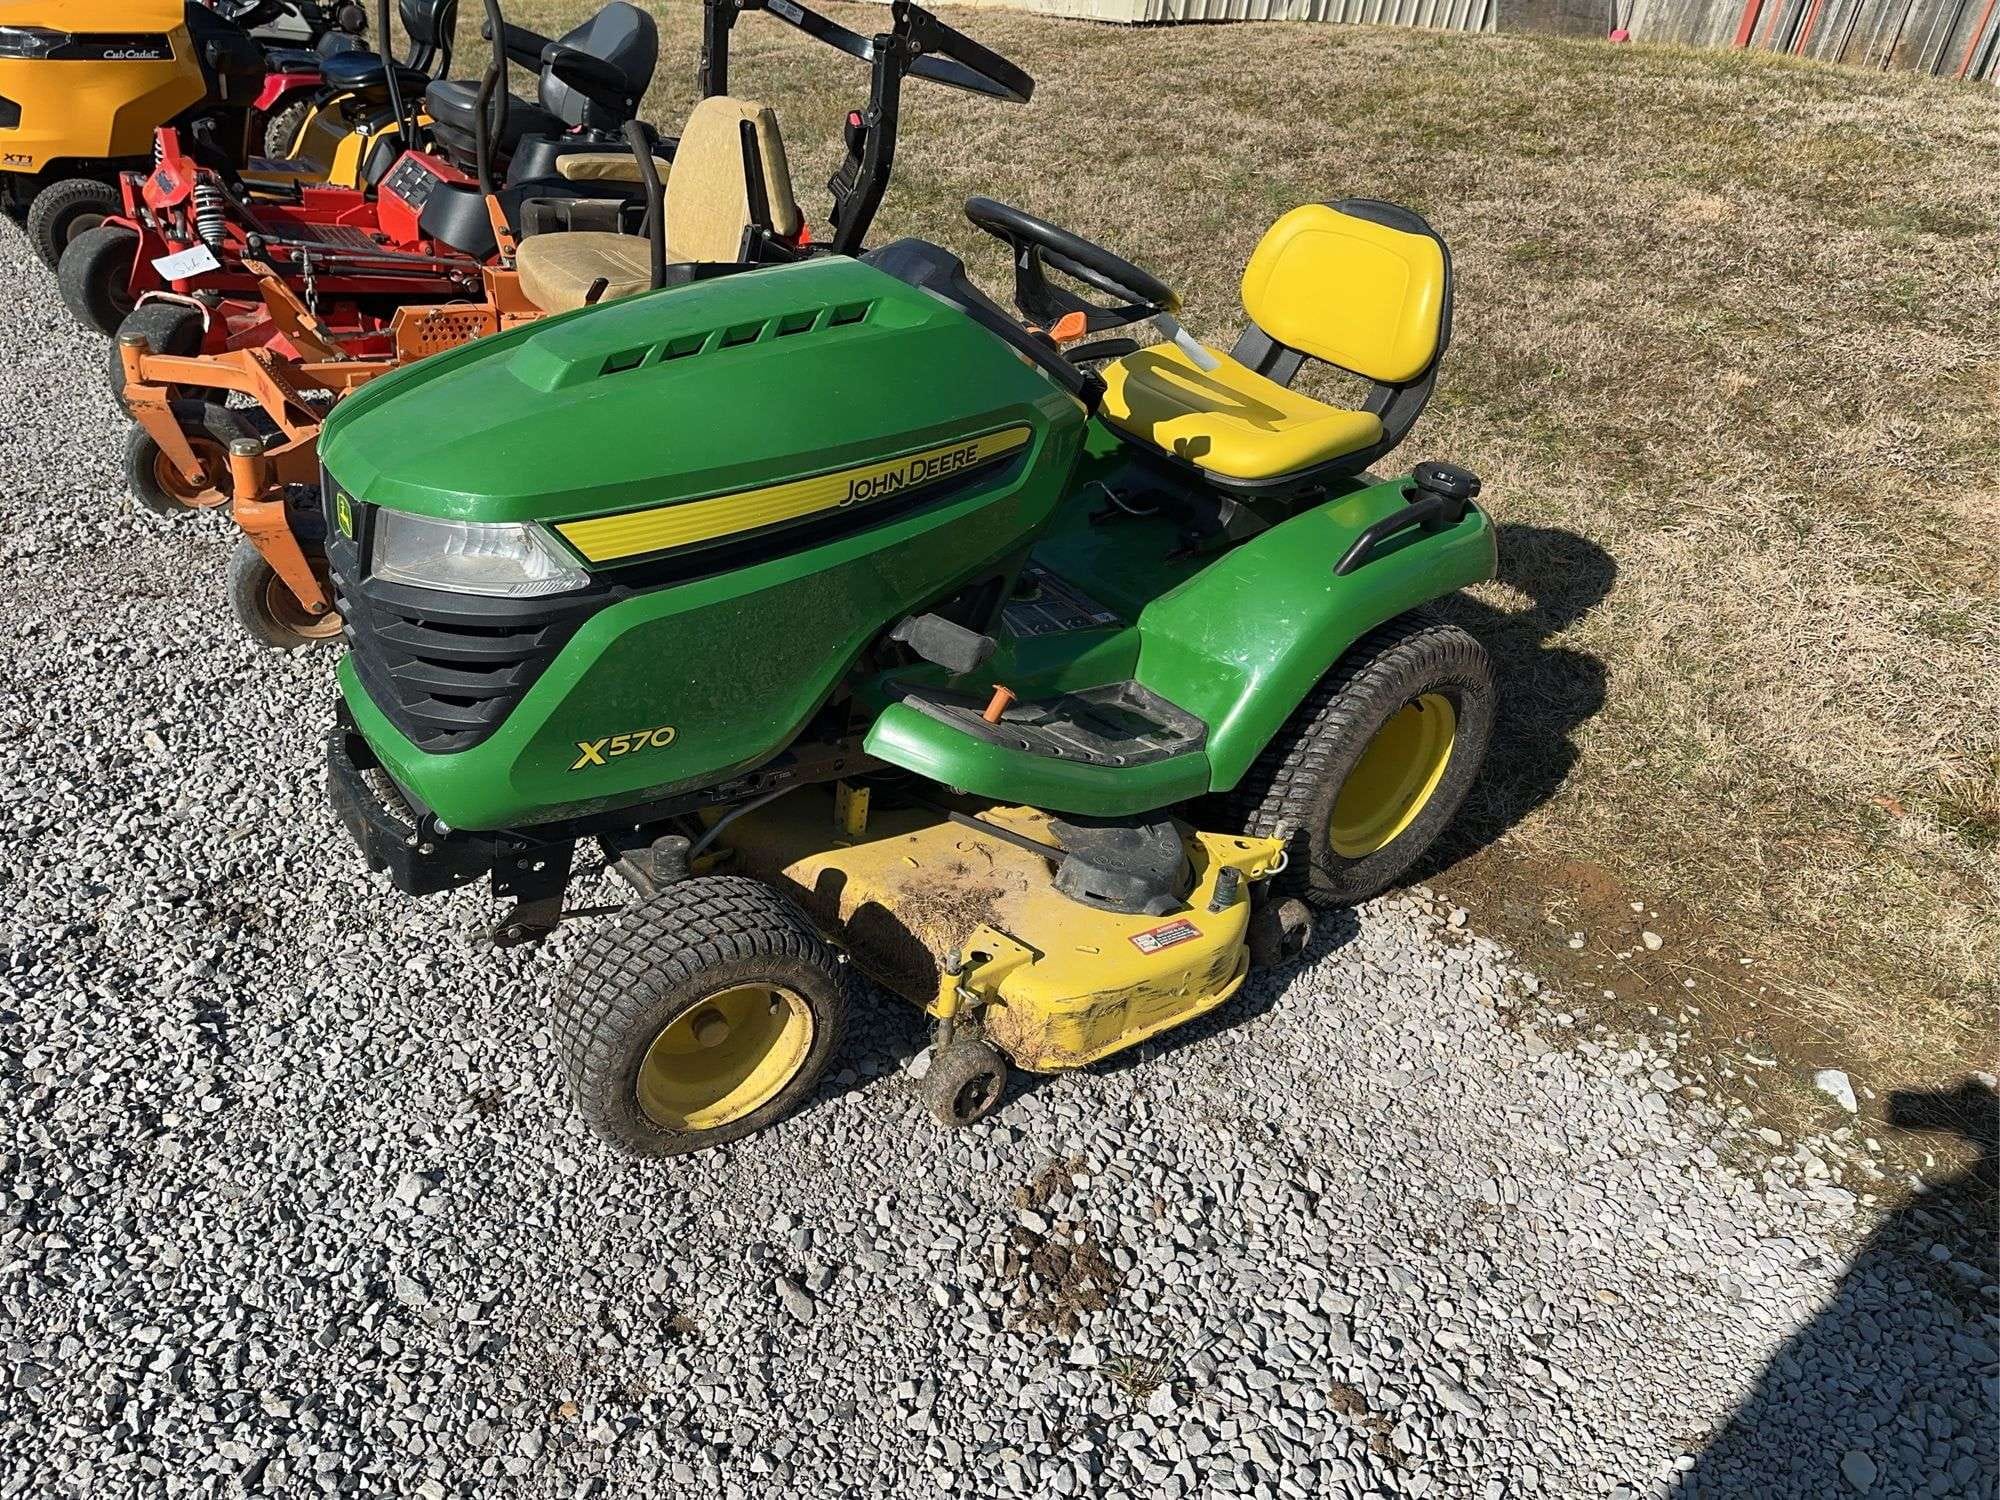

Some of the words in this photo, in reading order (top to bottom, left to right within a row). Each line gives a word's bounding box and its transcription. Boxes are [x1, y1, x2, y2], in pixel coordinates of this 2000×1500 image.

[103, 49, 124, 59] Cub
[125, 49, 160, 59] Cadet
[4, 153, 33, 163] XT1
[839, 468, 905, 506] JOHN
[908, 444, 979, 485] DEERE
[570, 726, 677, 770] X570
